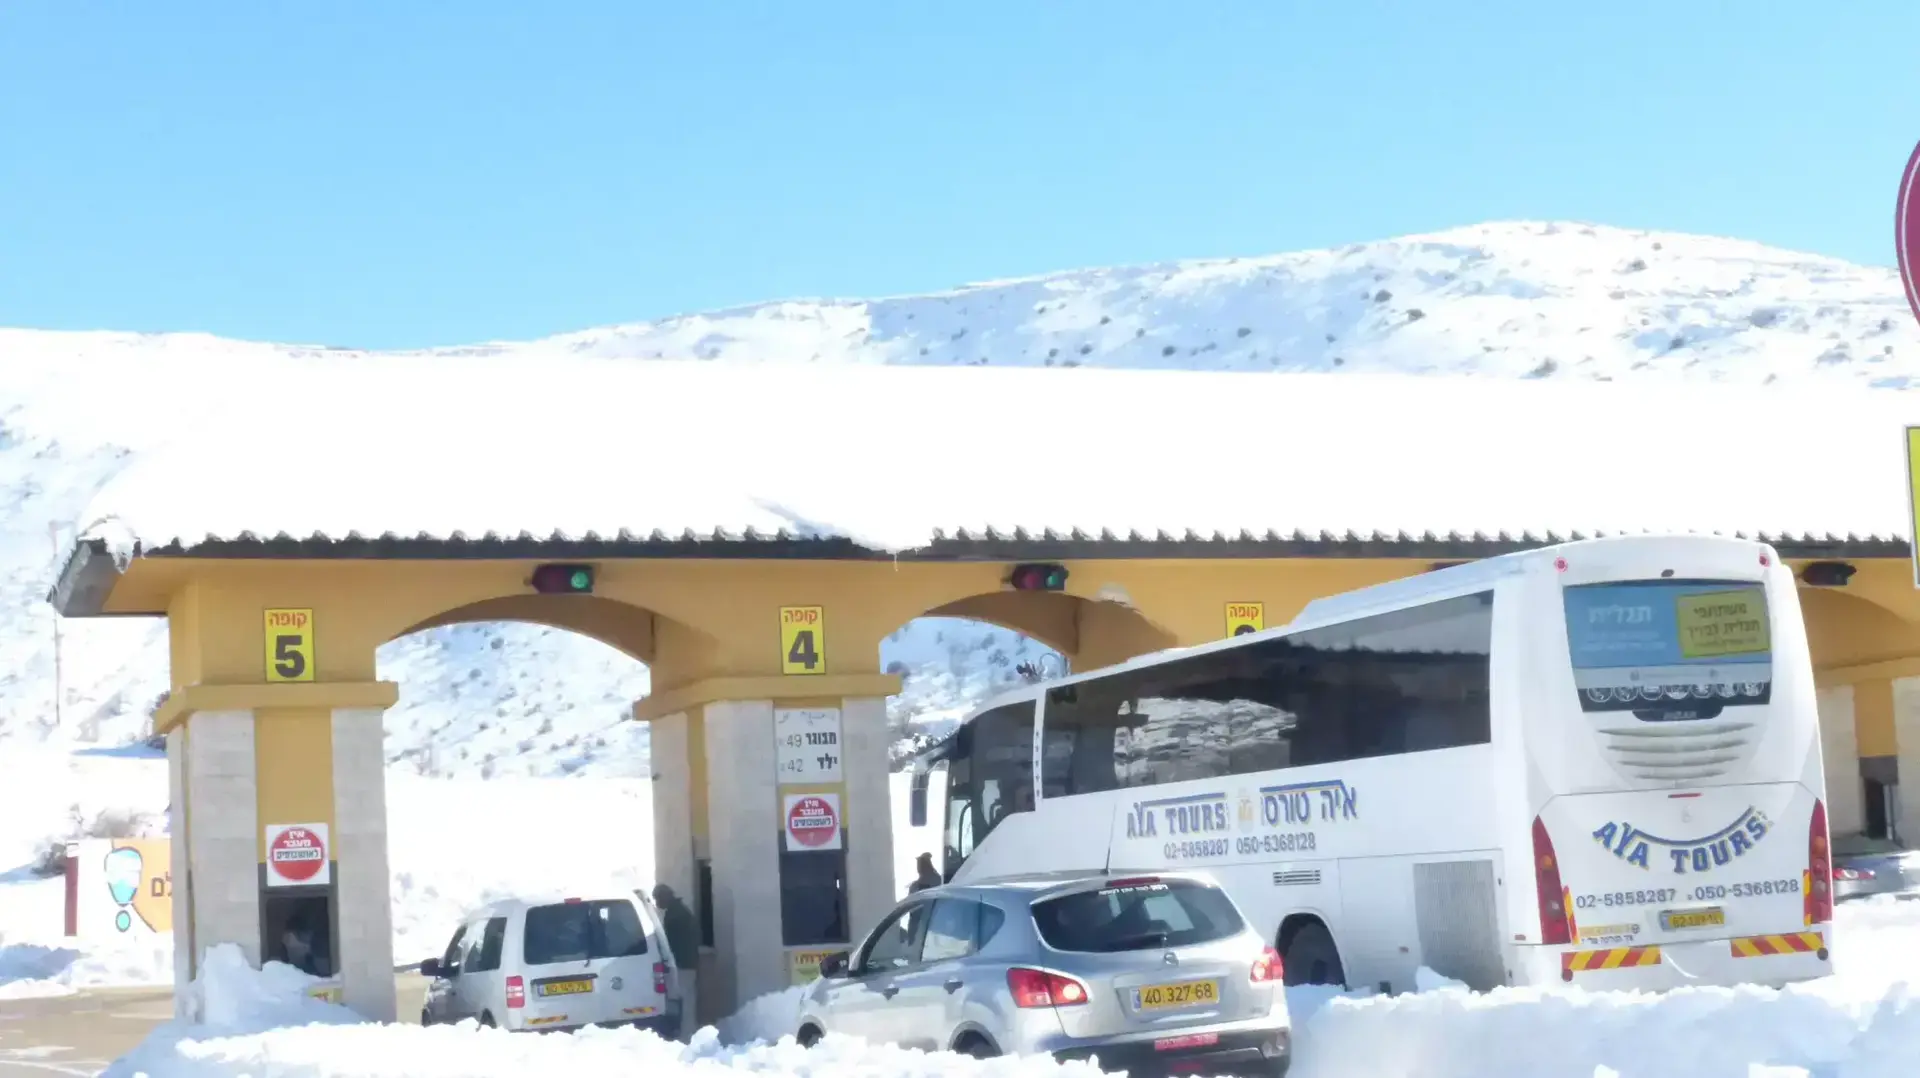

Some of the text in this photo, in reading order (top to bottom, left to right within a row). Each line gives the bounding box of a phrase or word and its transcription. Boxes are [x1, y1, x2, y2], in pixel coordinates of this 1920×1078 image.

[268, 612, 307, 629] קופה
[783, 609, 817, 625] קופה
[1229, 606, 1259, 621] קופה
[274, 634, 305, 678] 5
[788, 629, 818, 669] 4
[786, 733, 803, 748] 49
[787, 752, 838, 773] ילד 42
[1319, 784, 1359, 822] איה
[1126, 801, 1228, 839] AYA TOURS
[1236, 832, 1316, 855] 050-5368128
[1591, 814, 1768, 874] AYA TOURS
[1576, 888, 1677, 909] 02-5858287
